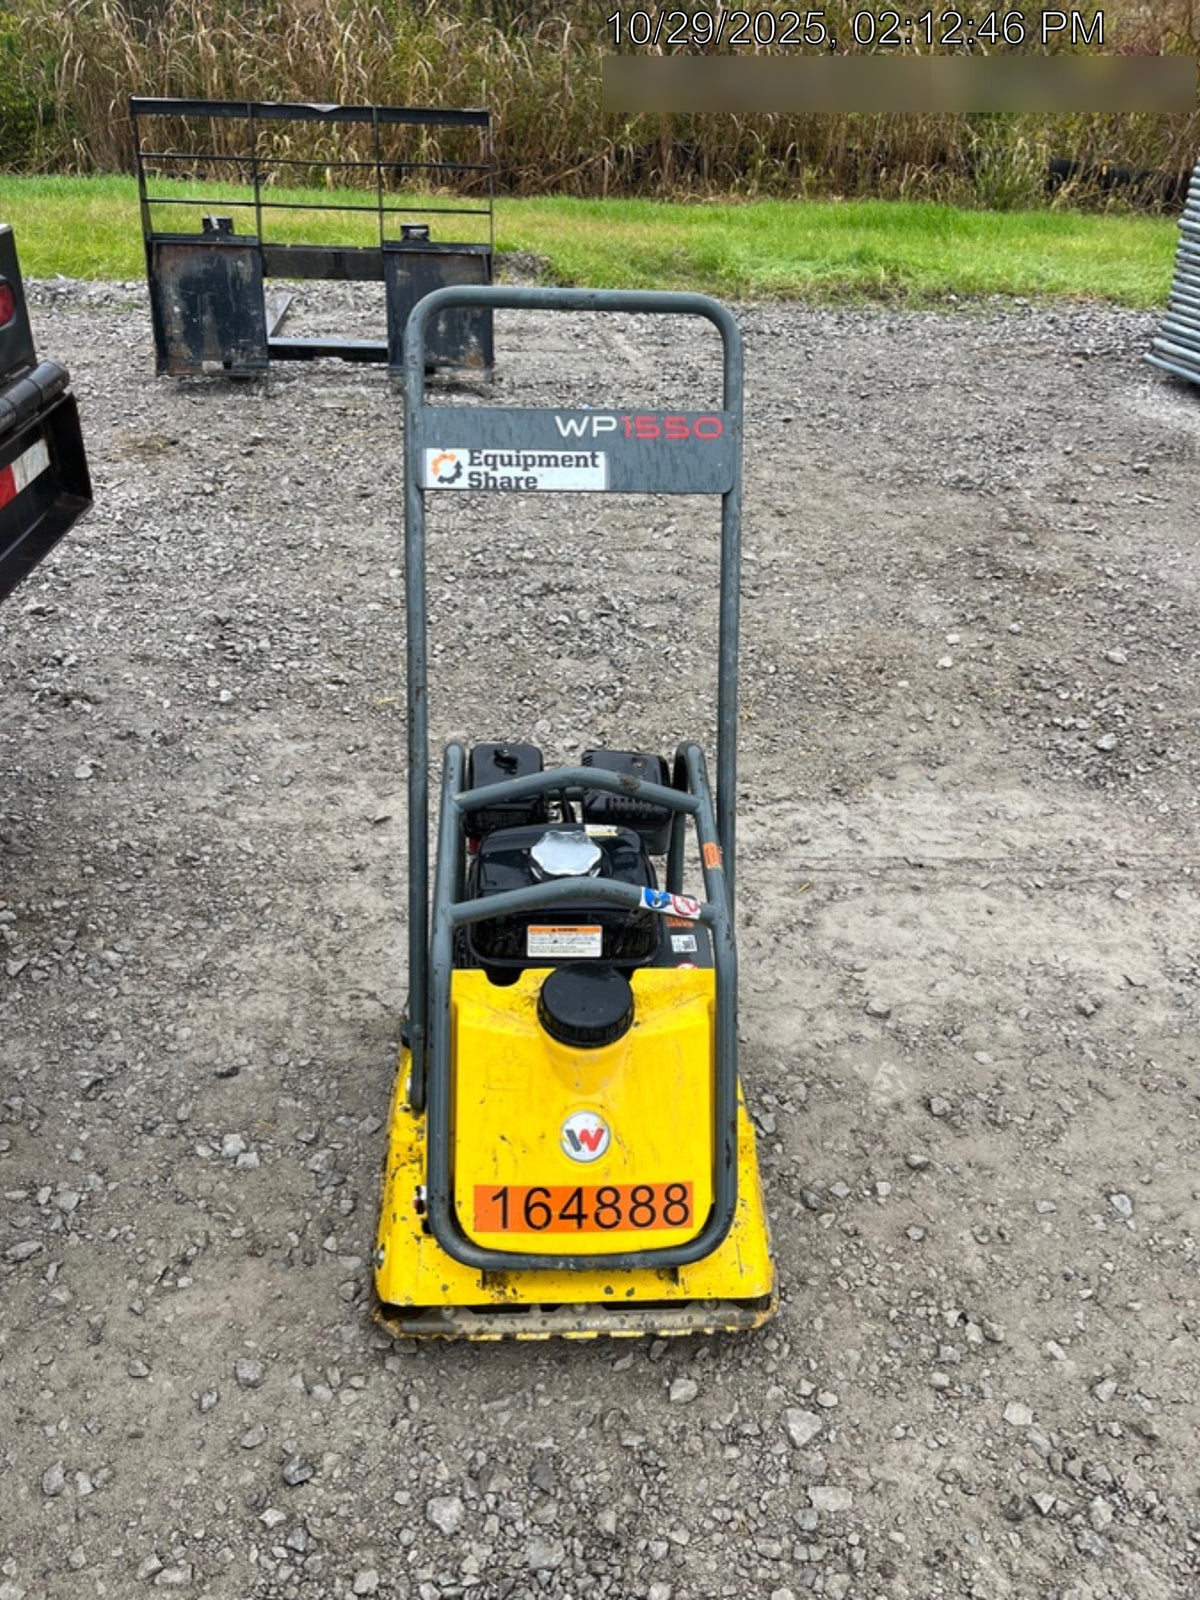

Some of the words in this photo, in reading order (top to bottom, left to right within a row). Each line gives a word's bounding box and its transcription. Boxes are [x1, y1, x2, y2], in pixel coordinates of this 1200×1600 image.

[555, 415, 723, 440] WP1550
[468, 450, 600, 471] Equipment
[468, 471, 538, 490] Share
[491, 1183, 690, 1230] 164888
